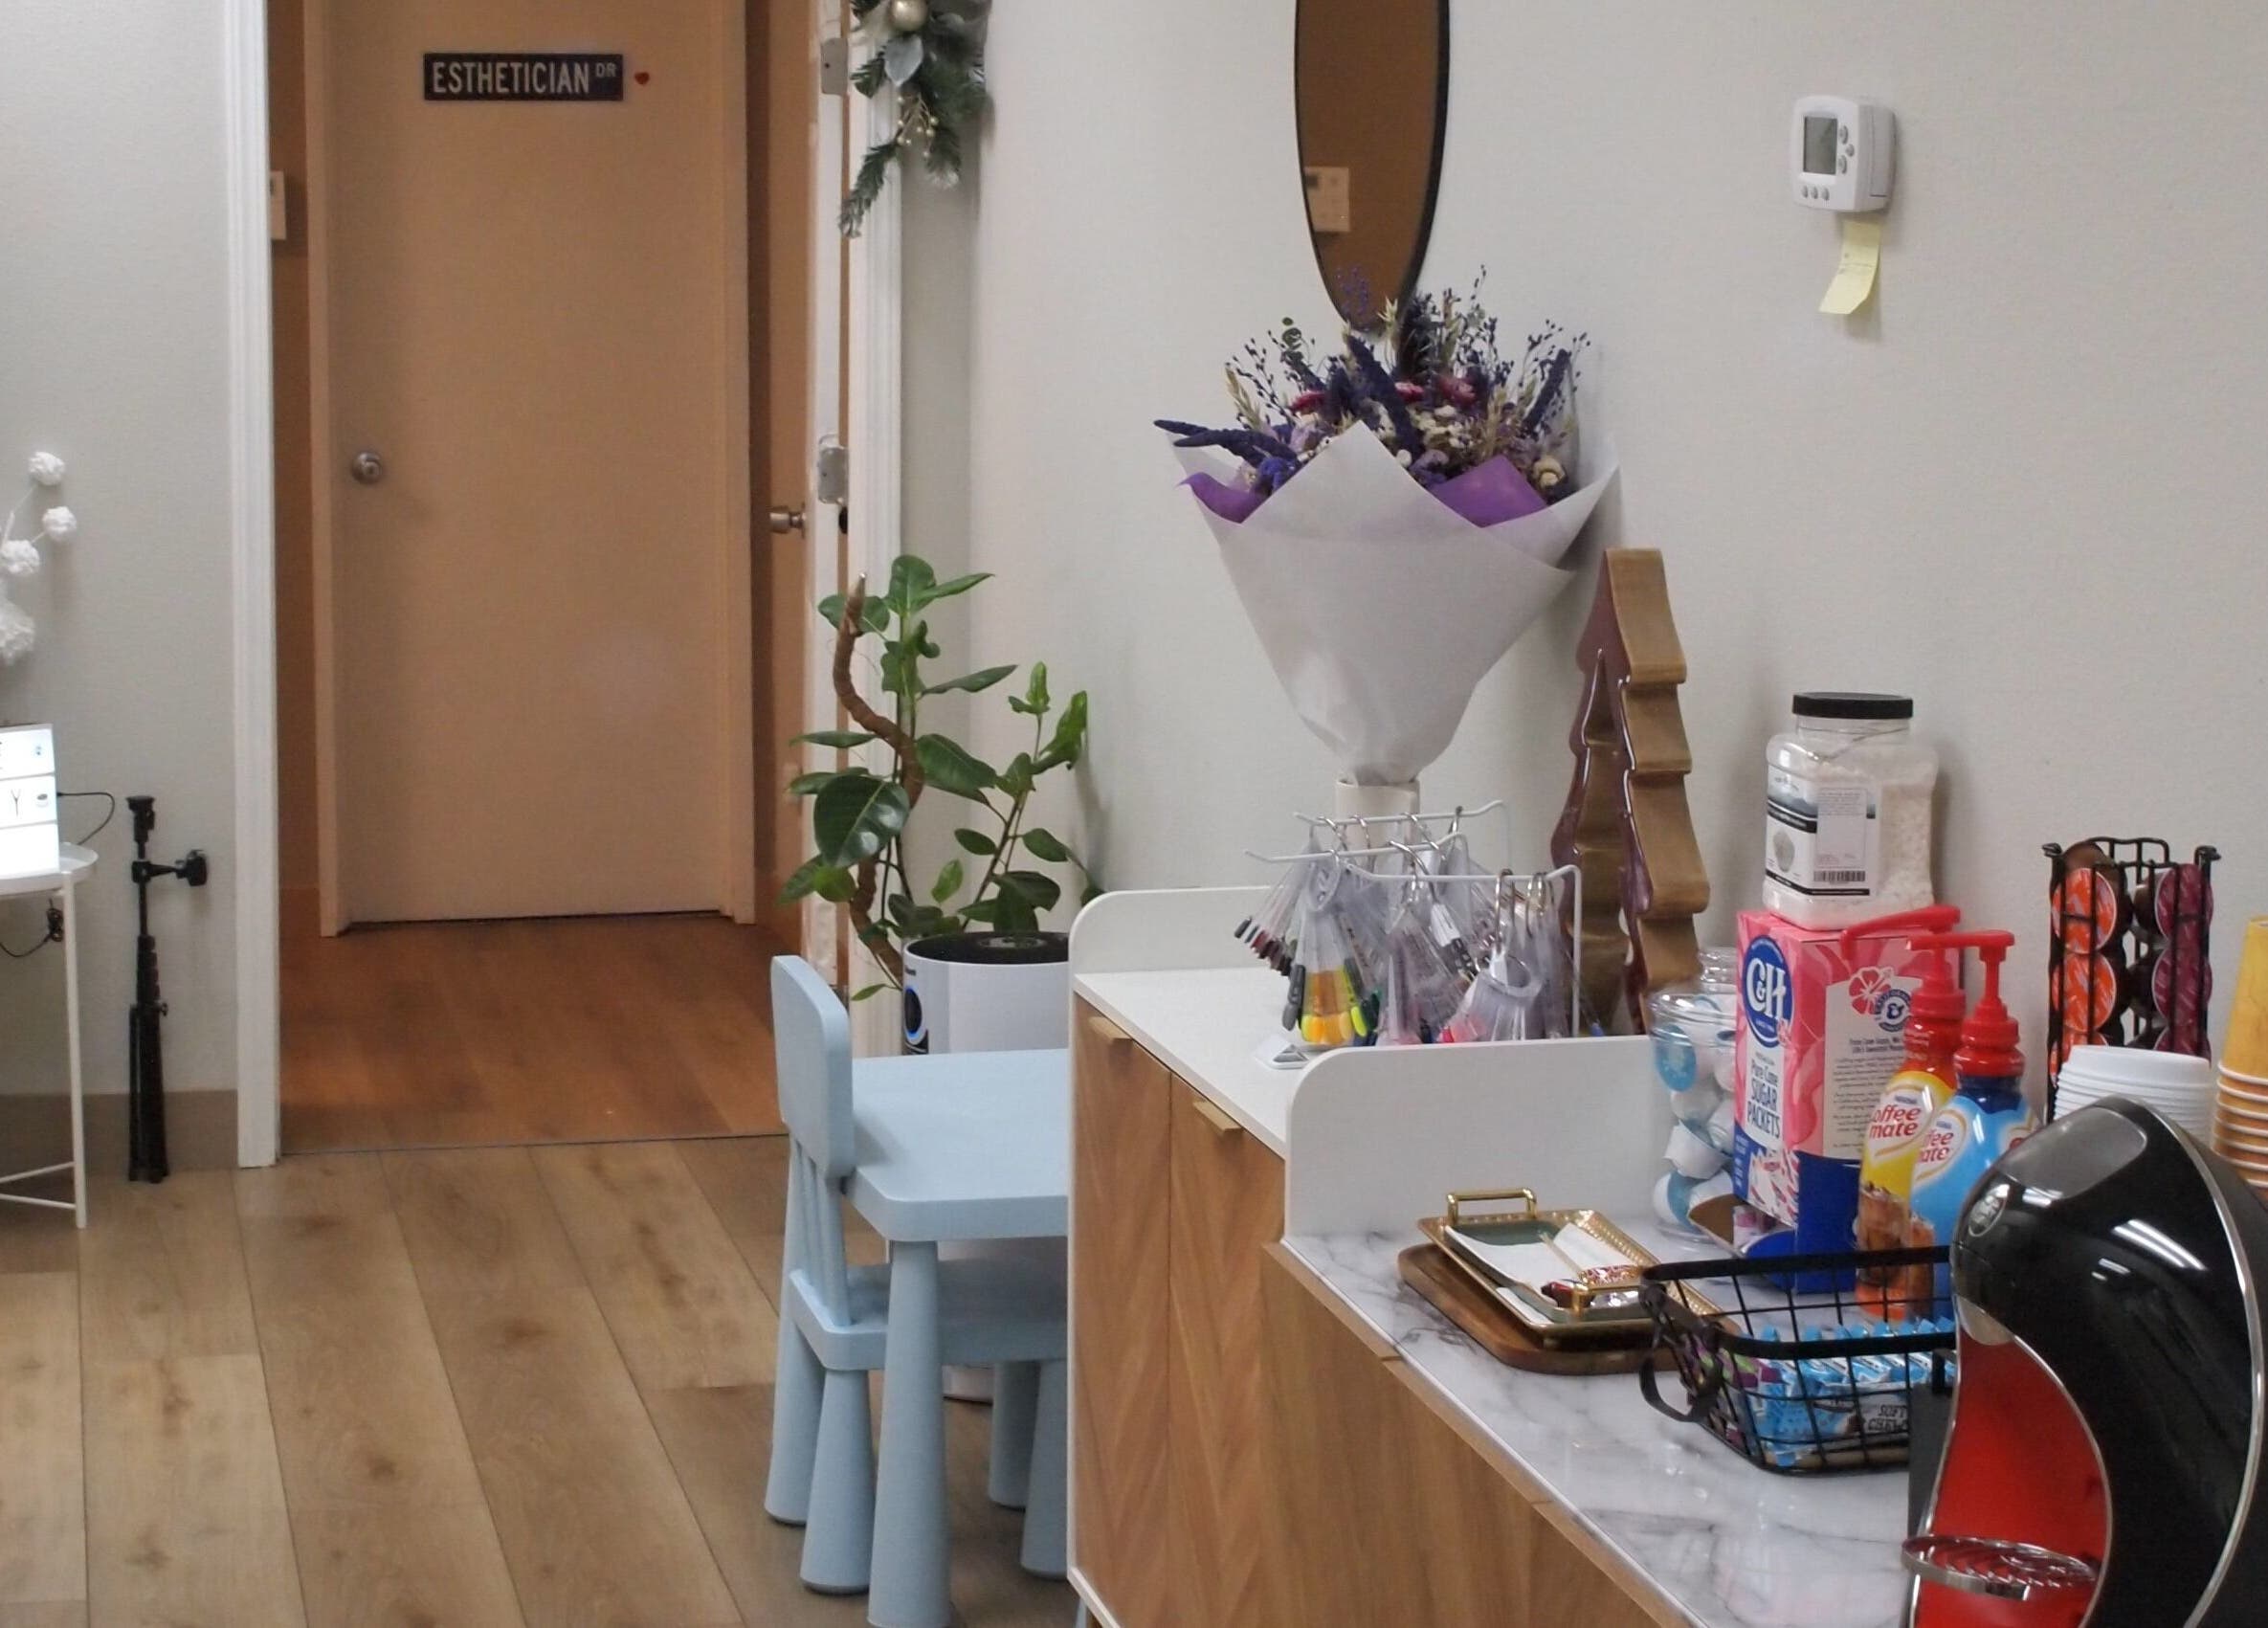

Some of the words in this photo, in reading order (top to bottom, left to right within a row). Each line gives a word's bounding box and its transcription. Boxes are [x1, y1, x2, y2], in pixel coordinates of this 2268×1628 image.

[432, 60, 589, 94] ESTHETICIAN
[595, 62, 617, 78] DR
[1745, 957, 1787, 1022] C&H
[1751, 1077, 1779, 1112] SUGAR
[1747, 1100, 1781, 1139] PACKETS
[1874, 1104, 1922, 1122] offee
[1868, 1122, 1919, 1139] mate
[1920, 1147, 1950, 1163] ate
